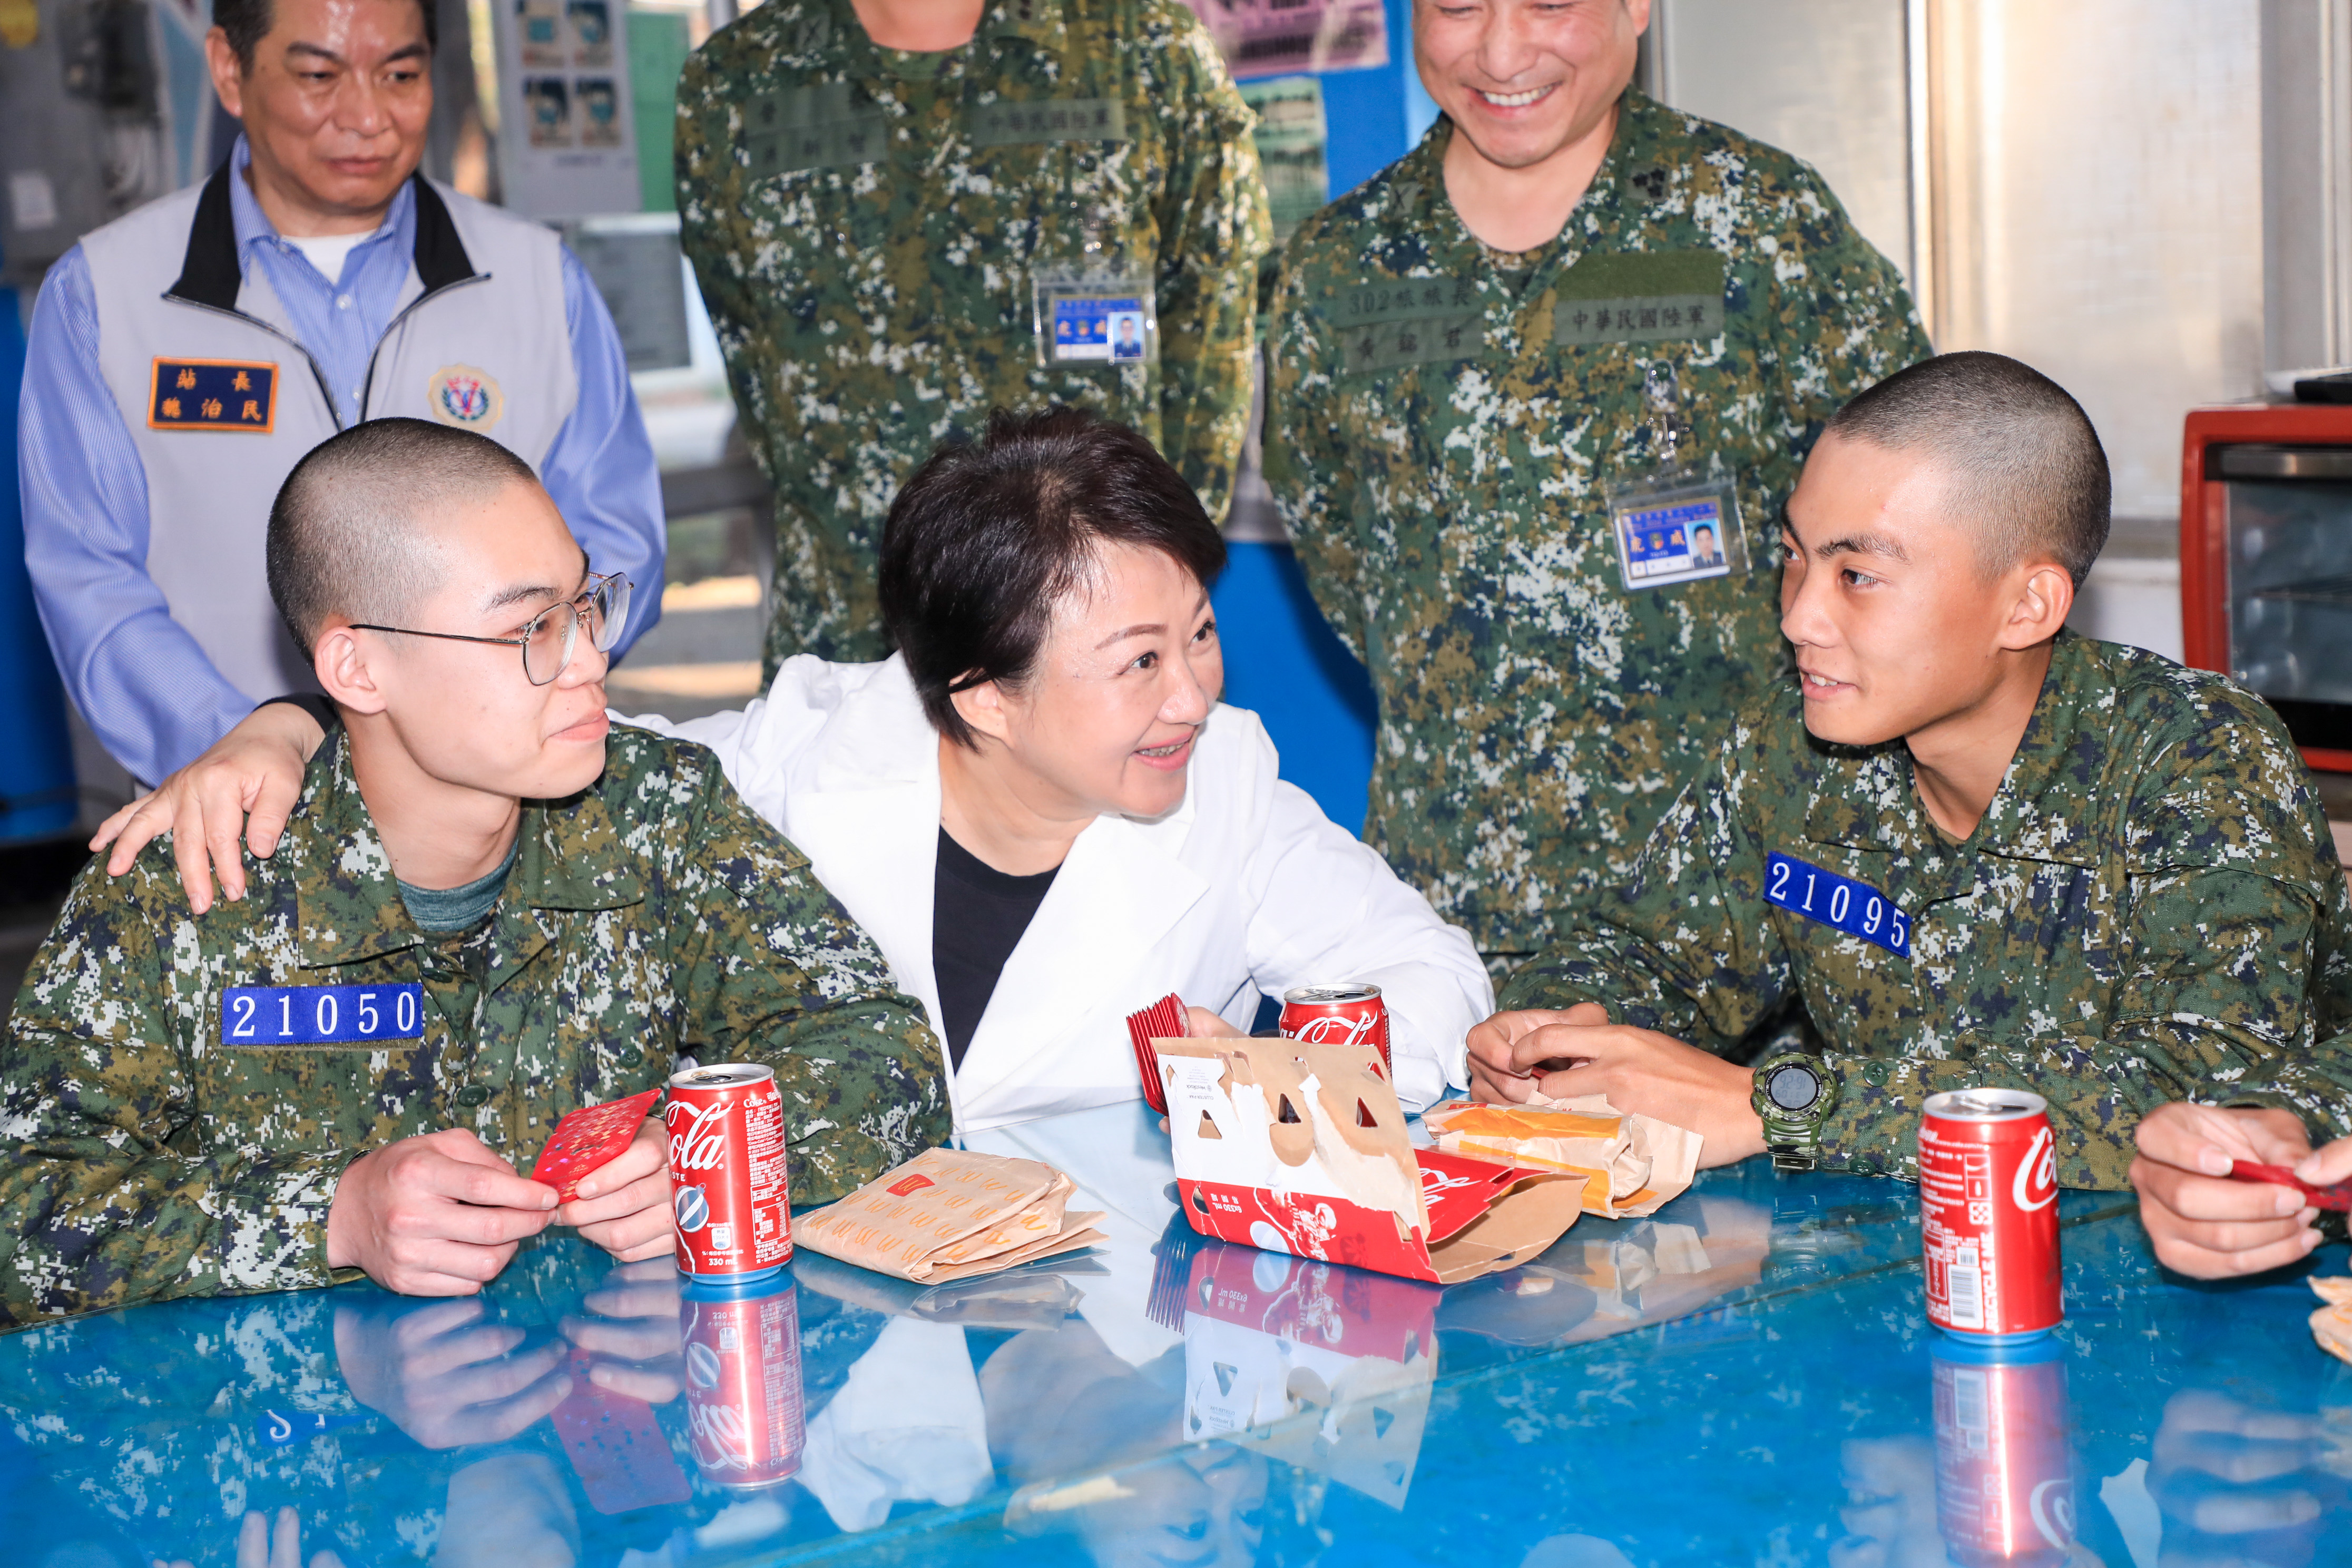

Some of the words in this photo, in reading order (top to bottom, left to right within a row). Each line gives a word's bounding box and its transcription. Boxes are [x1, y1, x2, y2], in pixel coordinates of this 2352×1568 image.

[1572, 305, 1704, 332] 中華民國陸軍
[176, 368, 252, 391] 站長
[1770, 862, 1905, 948] 21095
[232, 991, 415, 1037] 21050
[743, 1099, 763, 1108] Coke
[1210, 1193, 1239, 1204] 易開罐
[1212, 1202, 1223, 1210] mL
[1223, 1203, 1243, 1213] 6x330
[708, 1258, 723, 1266] 330
